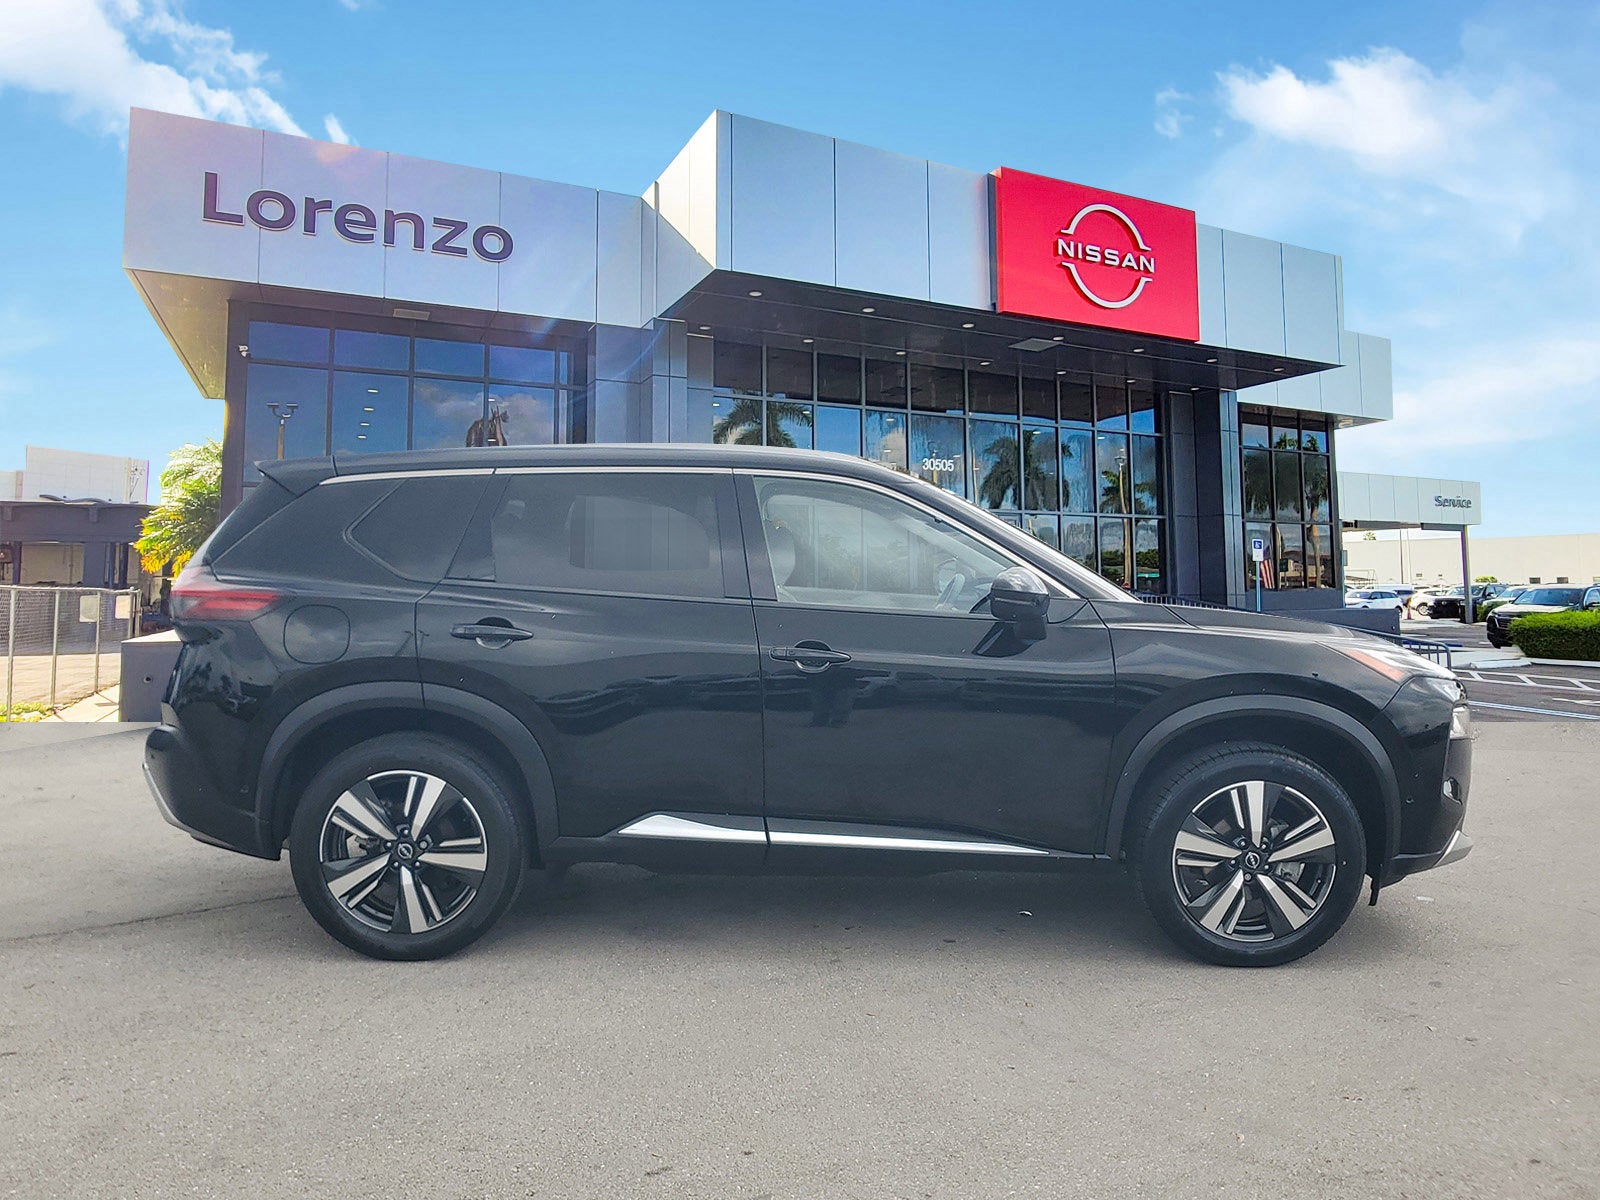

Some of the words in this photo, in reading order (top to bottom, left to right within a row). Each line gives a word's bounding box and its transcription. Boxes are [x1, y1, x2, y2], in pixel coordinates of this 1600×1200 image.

[202, 171, 514, 262] Lorenzo
[1057, 238, 1155, 273] NISSAN
[922, 458, 955, 472] 30505
[1434, 495, 1472, 509] Service
